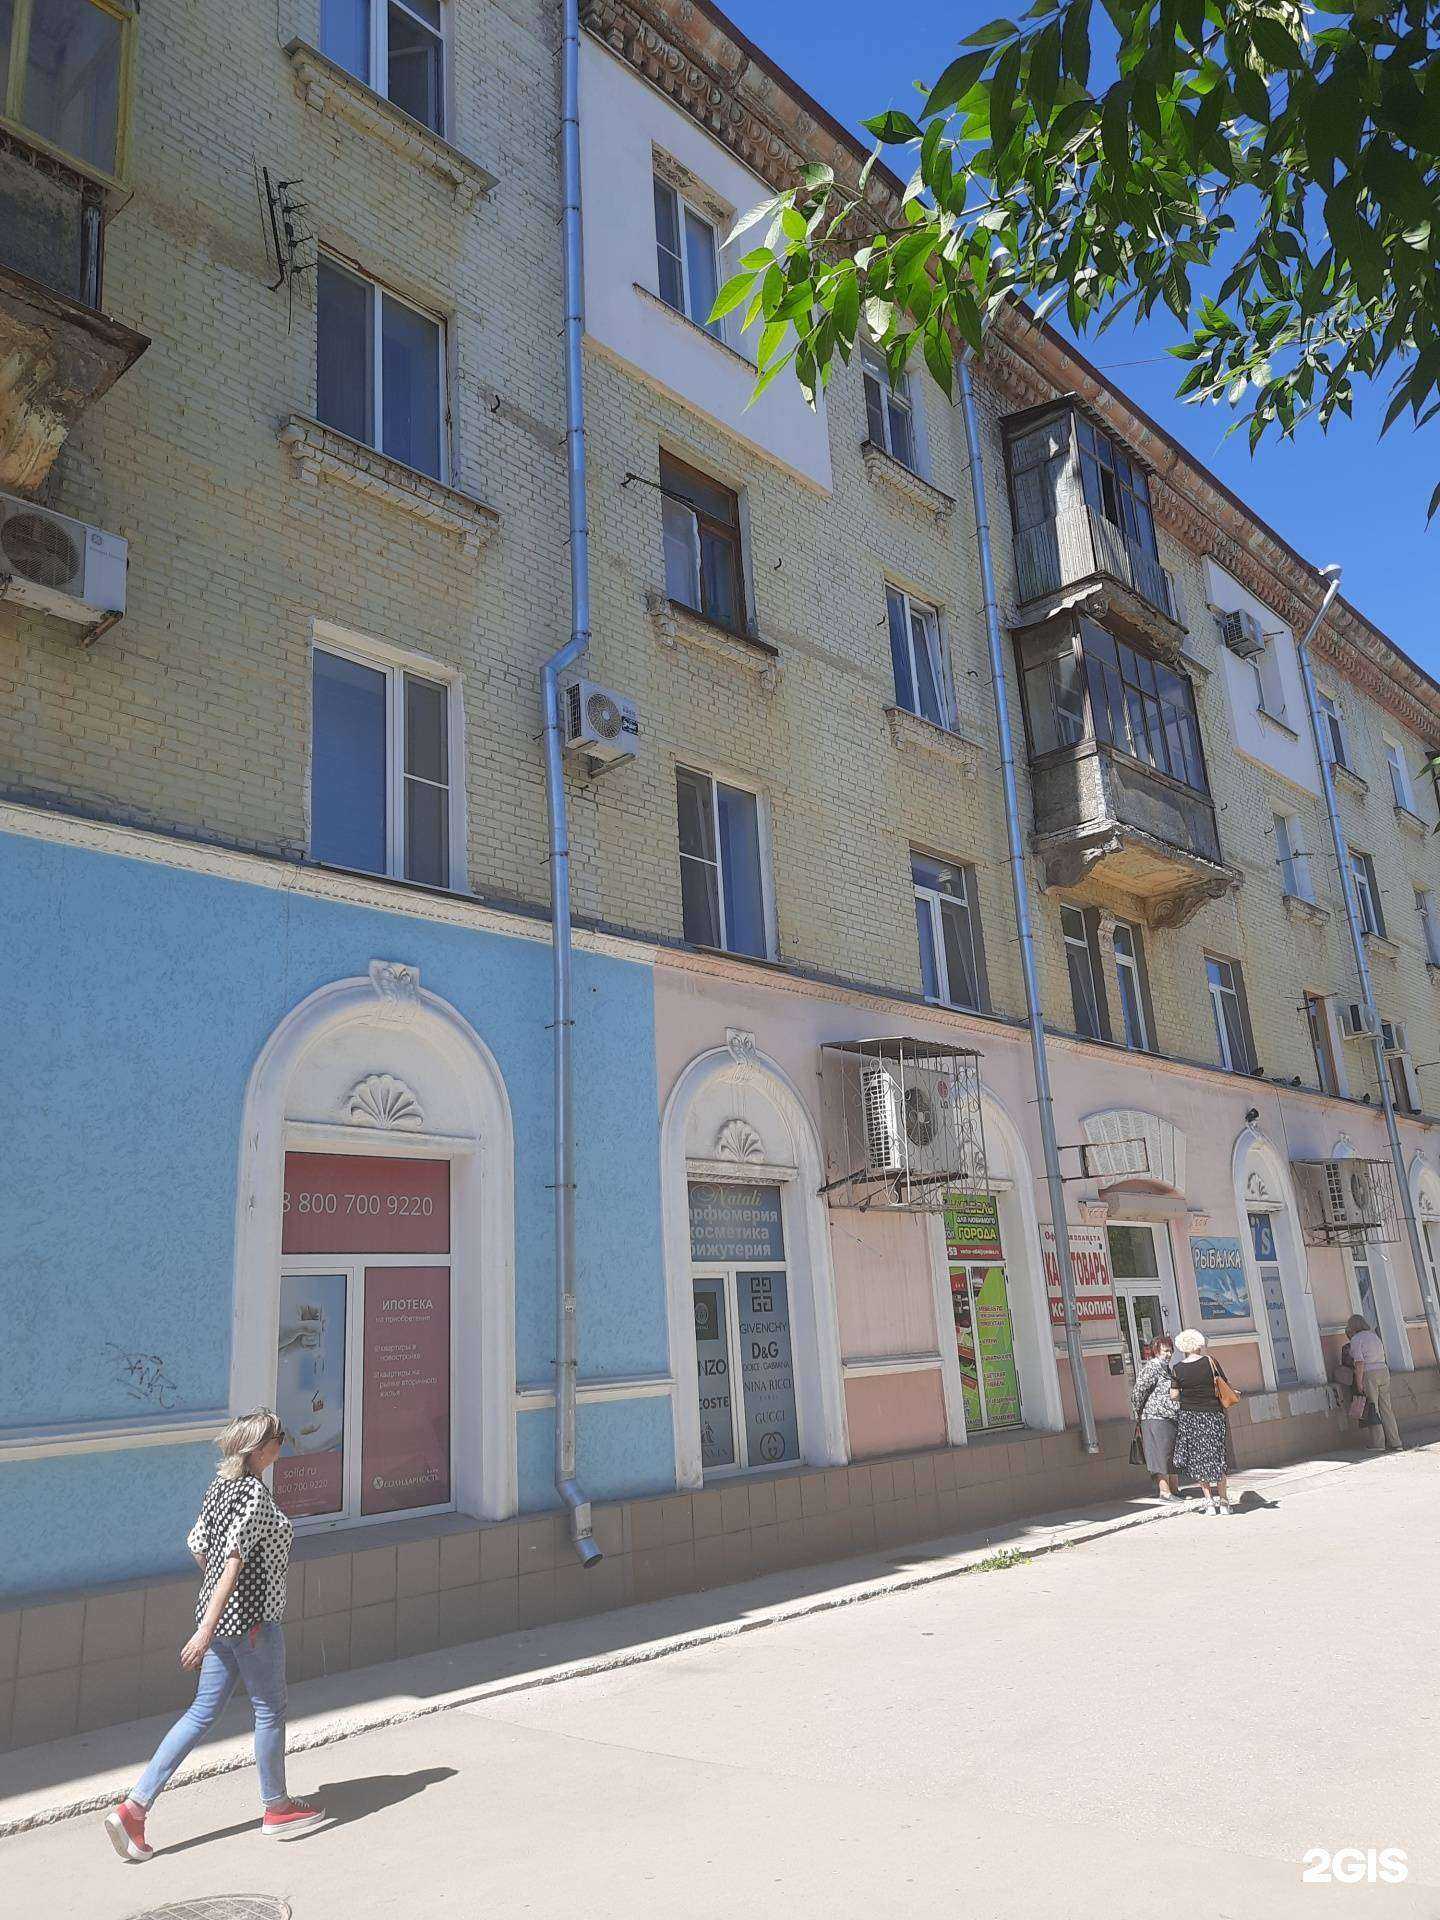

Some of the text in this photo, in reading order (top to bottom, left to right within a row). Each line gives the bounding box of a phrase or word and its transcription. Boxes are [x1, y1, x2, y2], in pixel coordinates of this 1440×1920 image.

[298, 1192, 337, 1214] 800
[344, 1194, 381, 1215] 700
[386, 1195, 433, 1216] 9220
[959, 1227, 997, 1240] ГОРОДА
[1194, 1248, 1241, 1269] РЫБАЛКА
[1044, 1251, 1110, 1287] КАТОВАРЫ
[383, 1299, 434, 1311] ИПОТЕКА
[1051, 1301, 1114, 1318] КСОКОПИЯ
[740, 1321, 786, 1335] GIVENCHY
[751, 1341, 779, 1360] D&G
[744, 1378, 792, 1393] NINA RICCI
[755, 1410, 785, 1424] GUCCI
